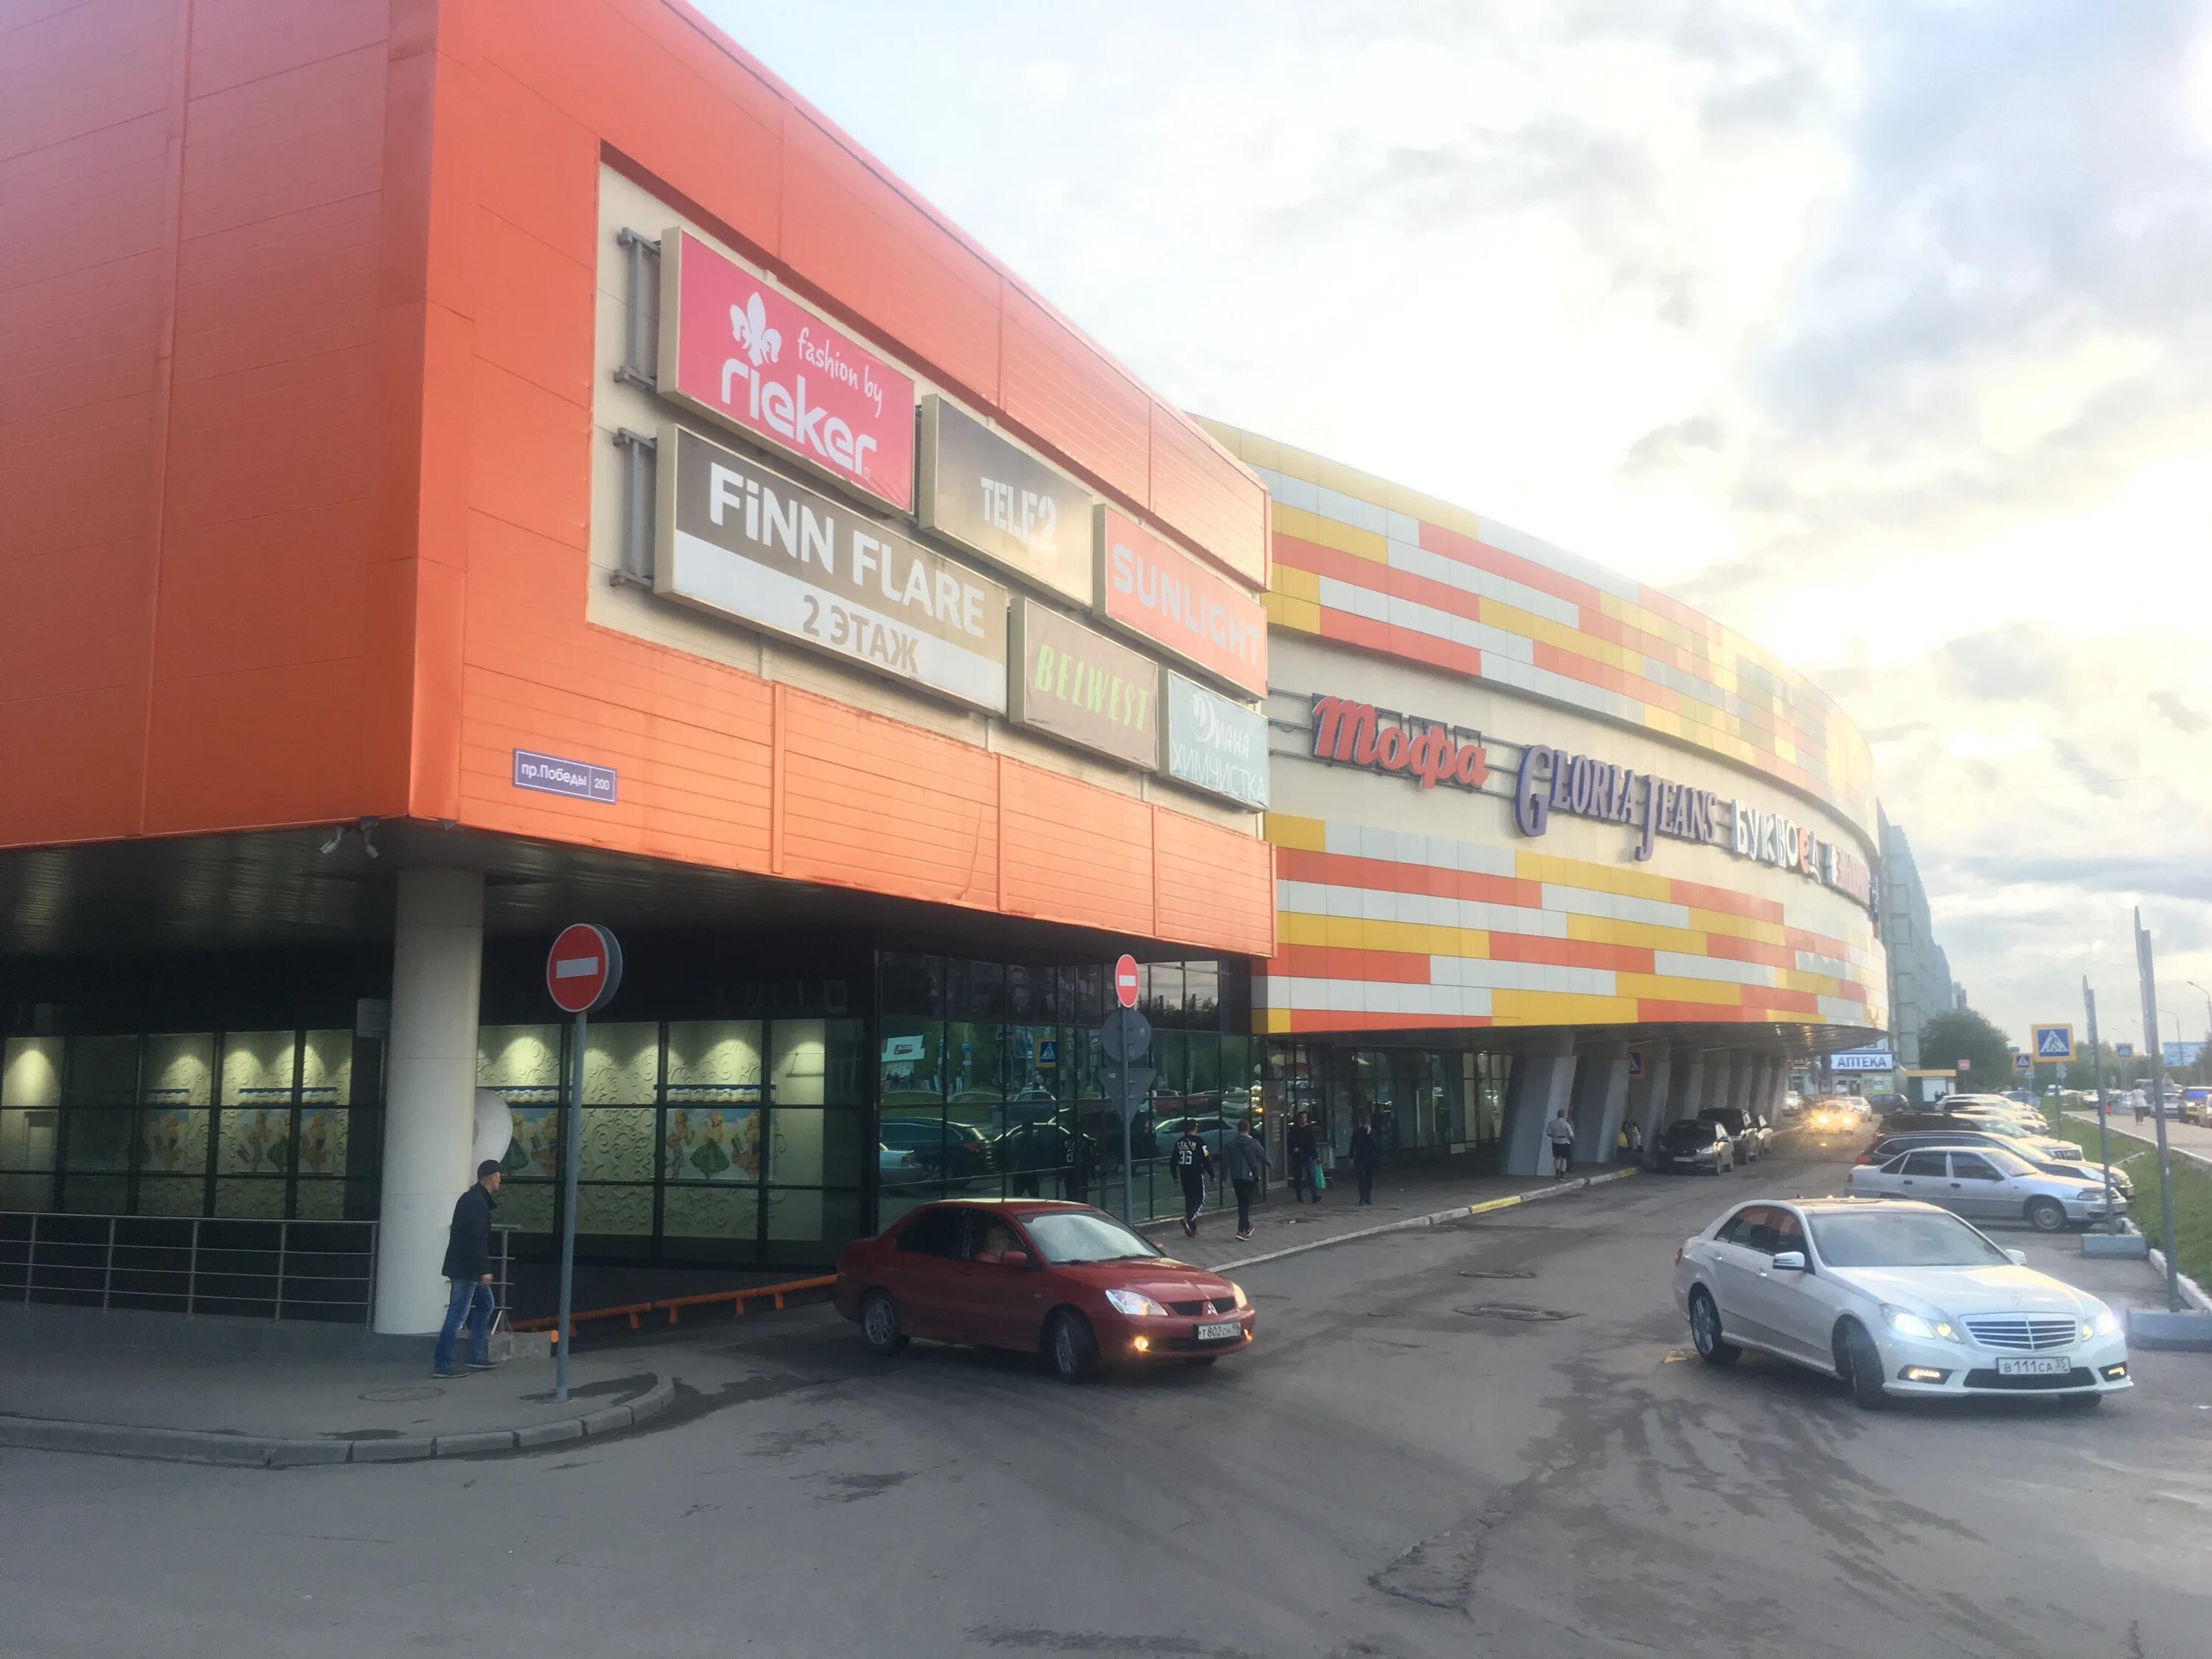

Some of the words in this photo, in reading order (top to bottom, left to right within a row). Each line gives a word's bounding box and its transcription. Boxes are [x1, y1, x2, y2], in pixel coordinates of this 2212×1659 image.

[797, 327, 858, 390] fashion
[864, 365, 883, 419] by
[721, 358, 877, 476] rieker
[981, 476, 1057, 550] TELE2
[852, 532, 985, 639] FLARE
[1111, 542, 1261, 667] SUNLIGHT
[803, 594, 820, 638] 2
[830, 608, 919, 675] ЭТАЖ
[1034, 642, 1150, 732] BELWEST
[594, 778, 610, 790] 200
[1172, 740, 1268, 801] ХИМЧИСТКА
[1837, 1056, 1887, 1068] АПТЕКА
